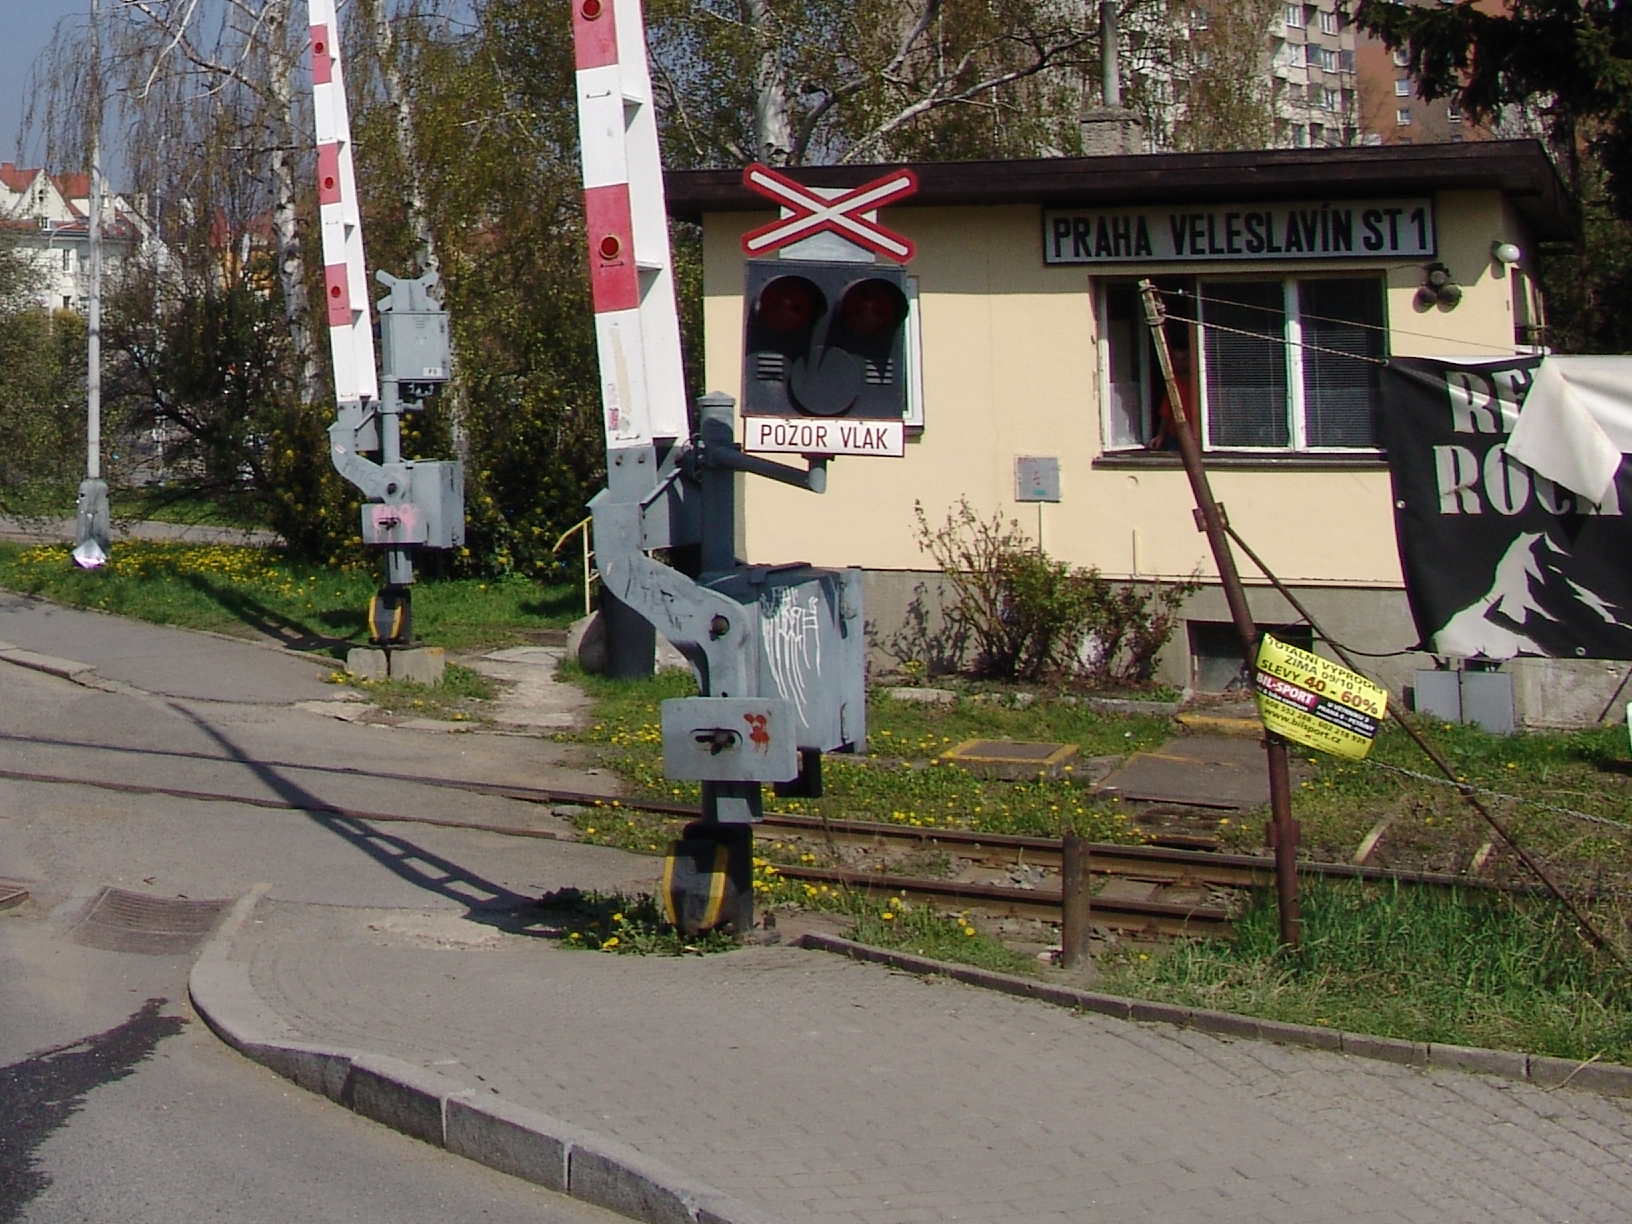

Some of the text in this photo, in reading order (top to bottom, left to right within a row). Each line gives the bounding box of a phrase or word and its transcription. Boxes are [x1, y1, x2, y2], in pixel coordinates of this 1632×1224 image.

[1052, 204, 1428, 258] PRAHA VELESLAVÍN ST 1
[1446, 368, 1540, 434] RE
[760, 423, 888, 450] POZOR VLAK
[1284, 654, 1318, 676] ZIMA
[1256, 671, 1315, 705] BIL-SPORT
[1260, 659, 1300, 682] SLEVY
[1304, 676, 1326, 693] 40
[1340, 690, 1378, 716] 60%
[1264, 707, 1342, 745] www.bilsport.cz
